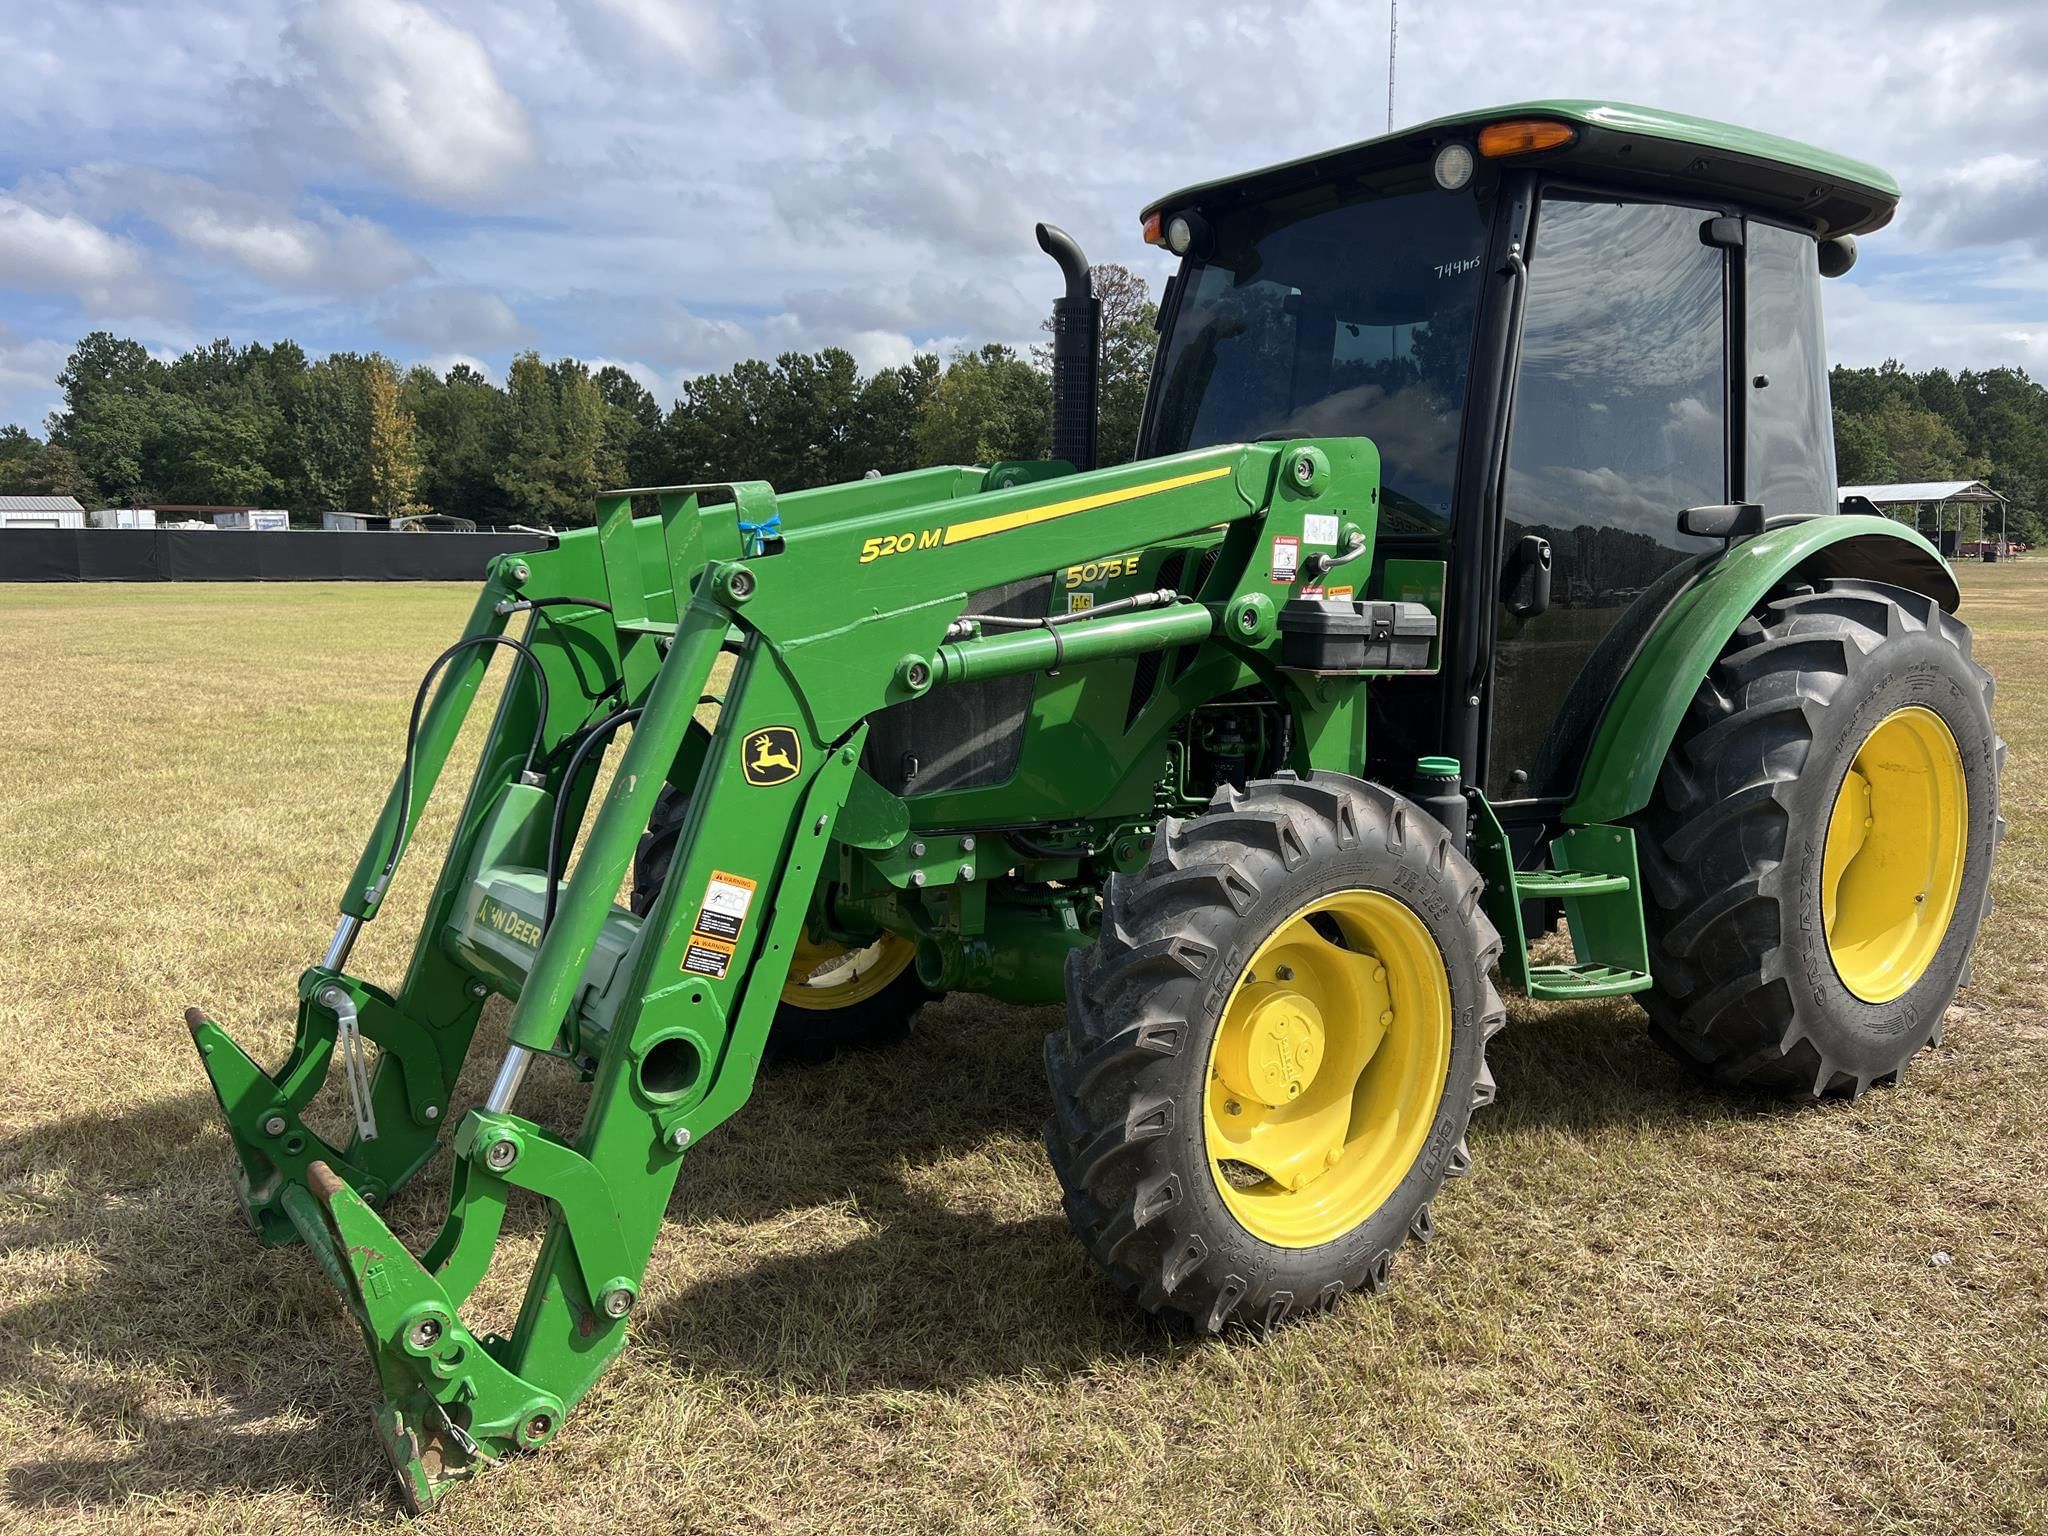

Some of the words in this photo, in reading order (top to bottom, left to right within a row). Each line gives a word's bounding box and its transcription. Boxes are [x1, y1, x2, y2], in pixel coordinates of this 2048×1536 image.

[859, 532, 916, 564] 520
[918, 527, 943, 551] M
[1065, 559, 1123, 589] 5075
[1125, 556, 1140, 577] E
[1072, 595, 1091, 609] AG
[723, 875, 751, 888] WARNING
[503, 911, 542, 948] DEER
[1800, 840, 1826, 1007] GALAXY
[701, 939, 730, 952] WARNING
